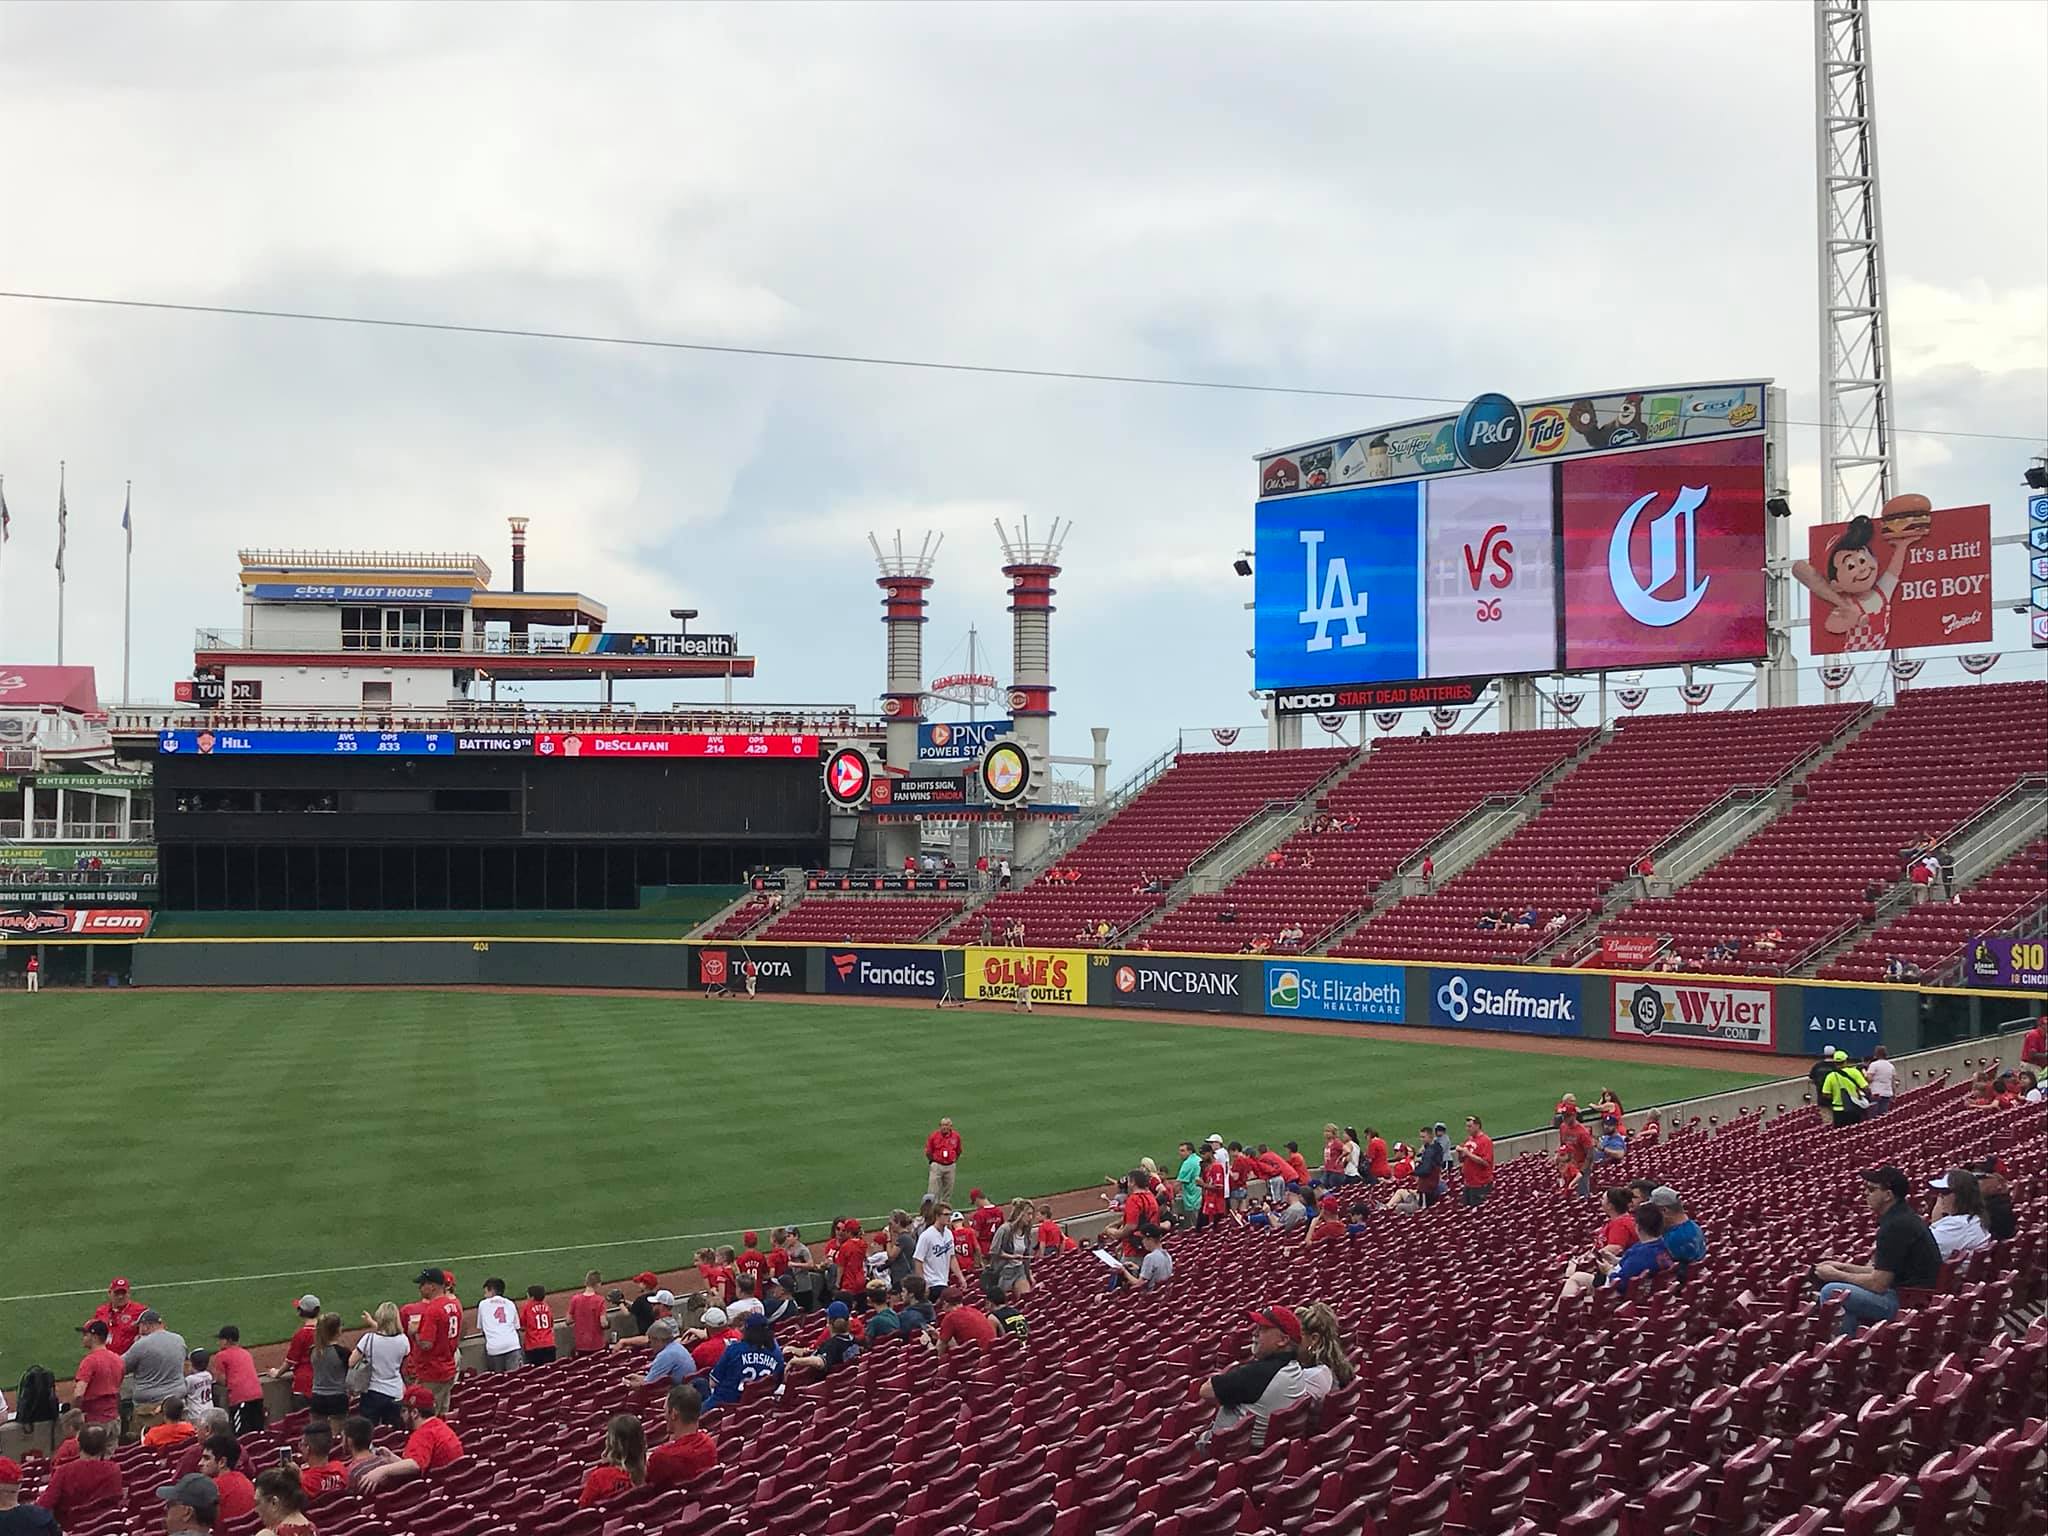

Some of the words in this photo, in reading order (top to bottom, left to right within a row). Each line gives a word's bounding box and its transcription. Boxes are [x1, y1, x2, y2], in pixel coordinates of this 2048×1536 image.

[1691, 399, 1733, 414] Crest
[1469, 416, 1515, 446] P&G
[1528, 416, 1565, 449] Tide
[1387, 433, 1432, 457] Swiffer
[1421, 450, 1455, 467] Pampers
[1464, 524, 1514, 592] VS
[1608, 484, 1711, 627] C
[1910, 547, 1934, 565] It's
[1938, 550, 1948, 561] a
[1951, 541, 1982, 561] Hit!
[295, 586, 335, 597] cbts
[343, 587, 384, 598] PILOT
[386, 588, 432, 599] HOUSE
[1299, 529, 1368, 654] LA
[1901, 578, 1937, 602] BIG
[1941, 575, 1984, 598] BOY
[650, 635, 730, 655] TriHealth
[1279, 693, 1335, 710] NOCO
[1338, 690, 1374, 706] START
[1376, 687, 1408, 704] DEAD
[1410, 683, 1472, 702] BATTERIES
[338, 733, 355, 743] AVG
[381, 733, 398, 743] OPS
[426, 733, 438, 743] HR
[707, 735, 724, 744] AVG
[748, 736, 764, 744] OPS
[952, 724, 995, 745] PNC
[334, 741, 357, 752] .333
[377, 741, 401, 752] .833
[427, 742, 436, 752] 0
[459, 738, 510, 750] BATTING
[512, 738, 532, 750] 9TH
[704, 744, 725, 754] .214
[745, 744, 768, 754] .429
[793, 744, 802, 754] 0
[920, 746, 960, 758] POWER
[37, 777, 69, 785] CENTER
[71, 777, 95, 785] FIELD
[97, 777, 135, 785] BULLPEN
[137, 777, 153, 786] DEC
[900, 781, 916, 790] RED
[916, 781, 934, 790] HITS
[934, 781, 957, 791] SIGN,
[893, 792, 908, 801] FAN
[909, 791, 931, 801] WINS
[931, 791, 963, 801] TUNDRA
[75, 850, 109, 858] LAURA'S
[1093, 955, 1110, 967] 370
[2011, 943, 2045, 971] $10
[861, 961, 935, 987] Fanatics
[1030, 987, 1073, 1001] OUTLET
[1301, 979, 1320, 1001] St.
[1323, 980, 1400, 1005] Elizabeth
[1323, 1002, 1401, 1015] HEALTHCARE
[1639, 1000, 1655, 1023] 45
[1676, 990, 1766, 1032] Wyler
[1825, 1017, 1877, 1034] DELTA
[1722, 1026, 1750, 1040] .COM
[493, 1306, 507, 1324] 4
[535, 1313, 549, 1330] 19
[741, 1352, 778, 1371] KERSHAW
